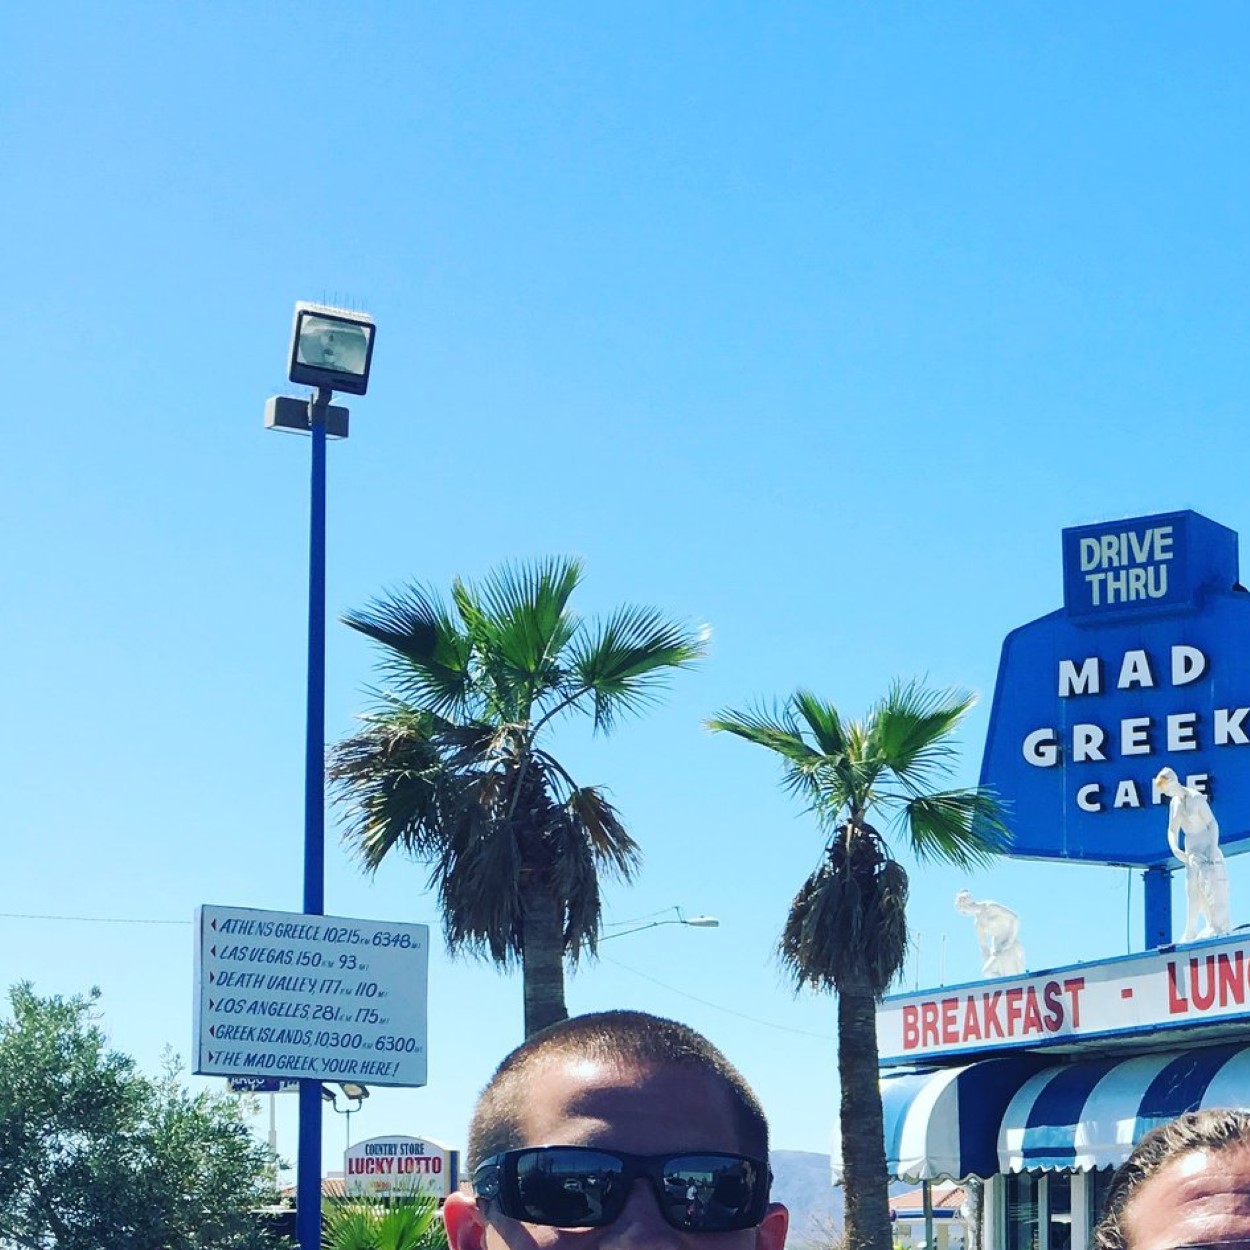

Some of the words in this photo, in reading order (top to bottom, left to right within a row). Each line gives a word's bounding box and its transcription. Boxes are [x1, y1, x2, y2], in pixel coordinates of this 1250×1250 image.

[1079, 525, 1174, 571] DRIVE
[1085, 564, 1167, 606] THRU
[1057, 645, 1206, 698] MAD
[219, 918, 275, 937] ATHENS
[220, 945, 249, 962] LAS
[296, 951, 322, 967] 150
[339, 954, 357, 970] 93
[216, 970, 266, 989] DEATH
[320, 979, 342, 994] 177
[354, 982, 378, 998] 110
[215, 998, 247, 1014] LOS
[312, 1004, 341, 1021] 281
[354, 1008, 379, 1024] 175
[902, 977, 1085, 1051] BREAKFAST
[216, 1024, 257, 1042] GREEK
[214, 1050, 242, 1068] THE
[243, 1052, 276, 1069] MAD
[321, 1057, 359, 1075] YOUR
[359, 1060, 400, 1078] HERE!
[365, 1143, 397, 1156] COUNTRY
[400, 1143, 425, 1156] STORE
[348, 1156, 394, 1175] LUCKY
[397, 1156, 442, 1175] LOTTO
